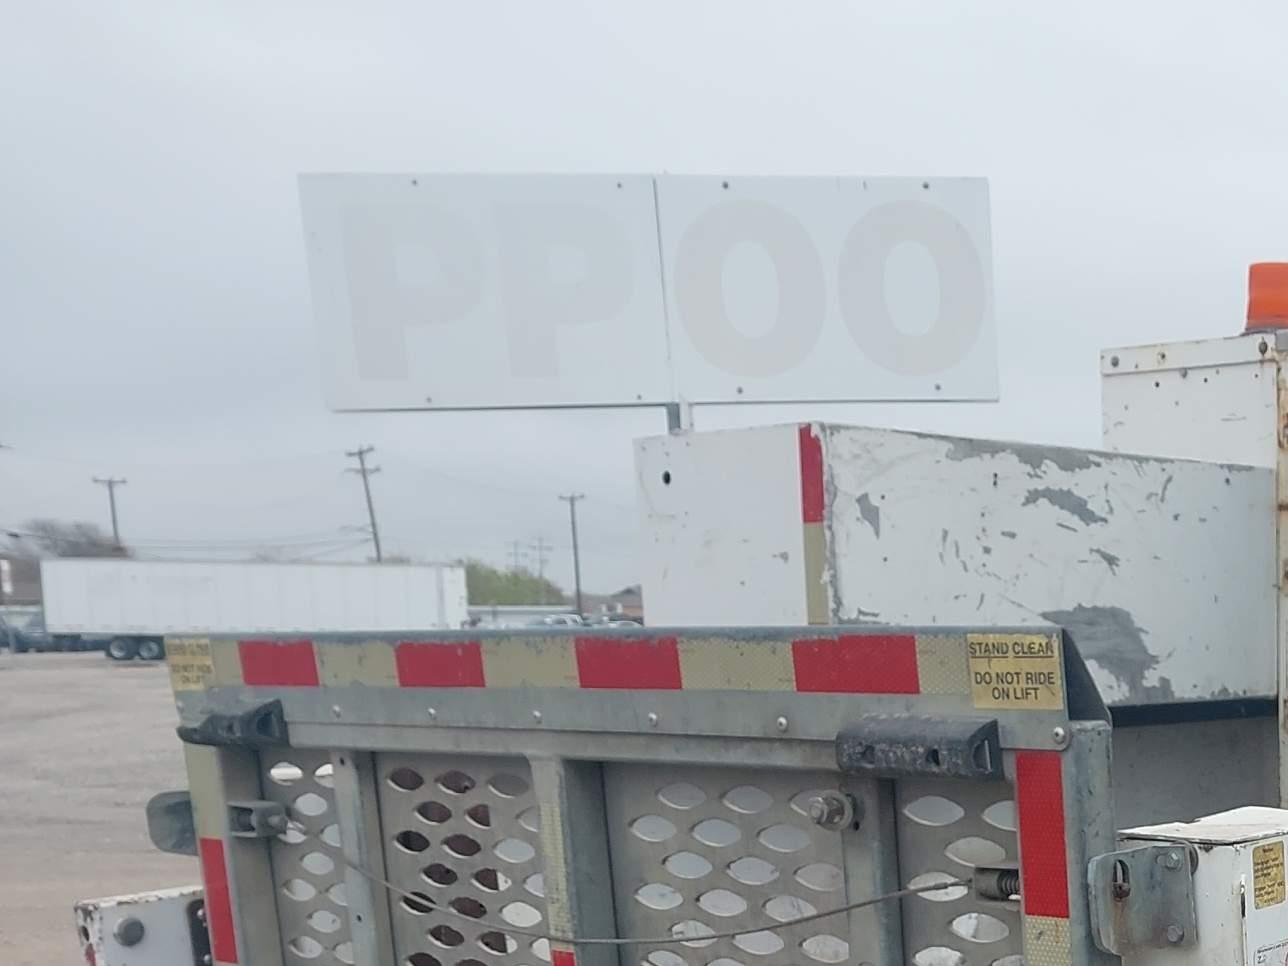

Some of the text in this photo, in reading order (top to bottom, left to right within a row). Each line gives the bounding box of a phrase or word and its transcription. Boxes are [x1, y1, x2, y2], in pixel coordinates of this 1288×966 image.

[969, 642, 1054, 655] STAND CLEAR
[975, 672, 1055, 685] DO NOT RIDE
[992, 687, 1040, 700] ON LIFT
